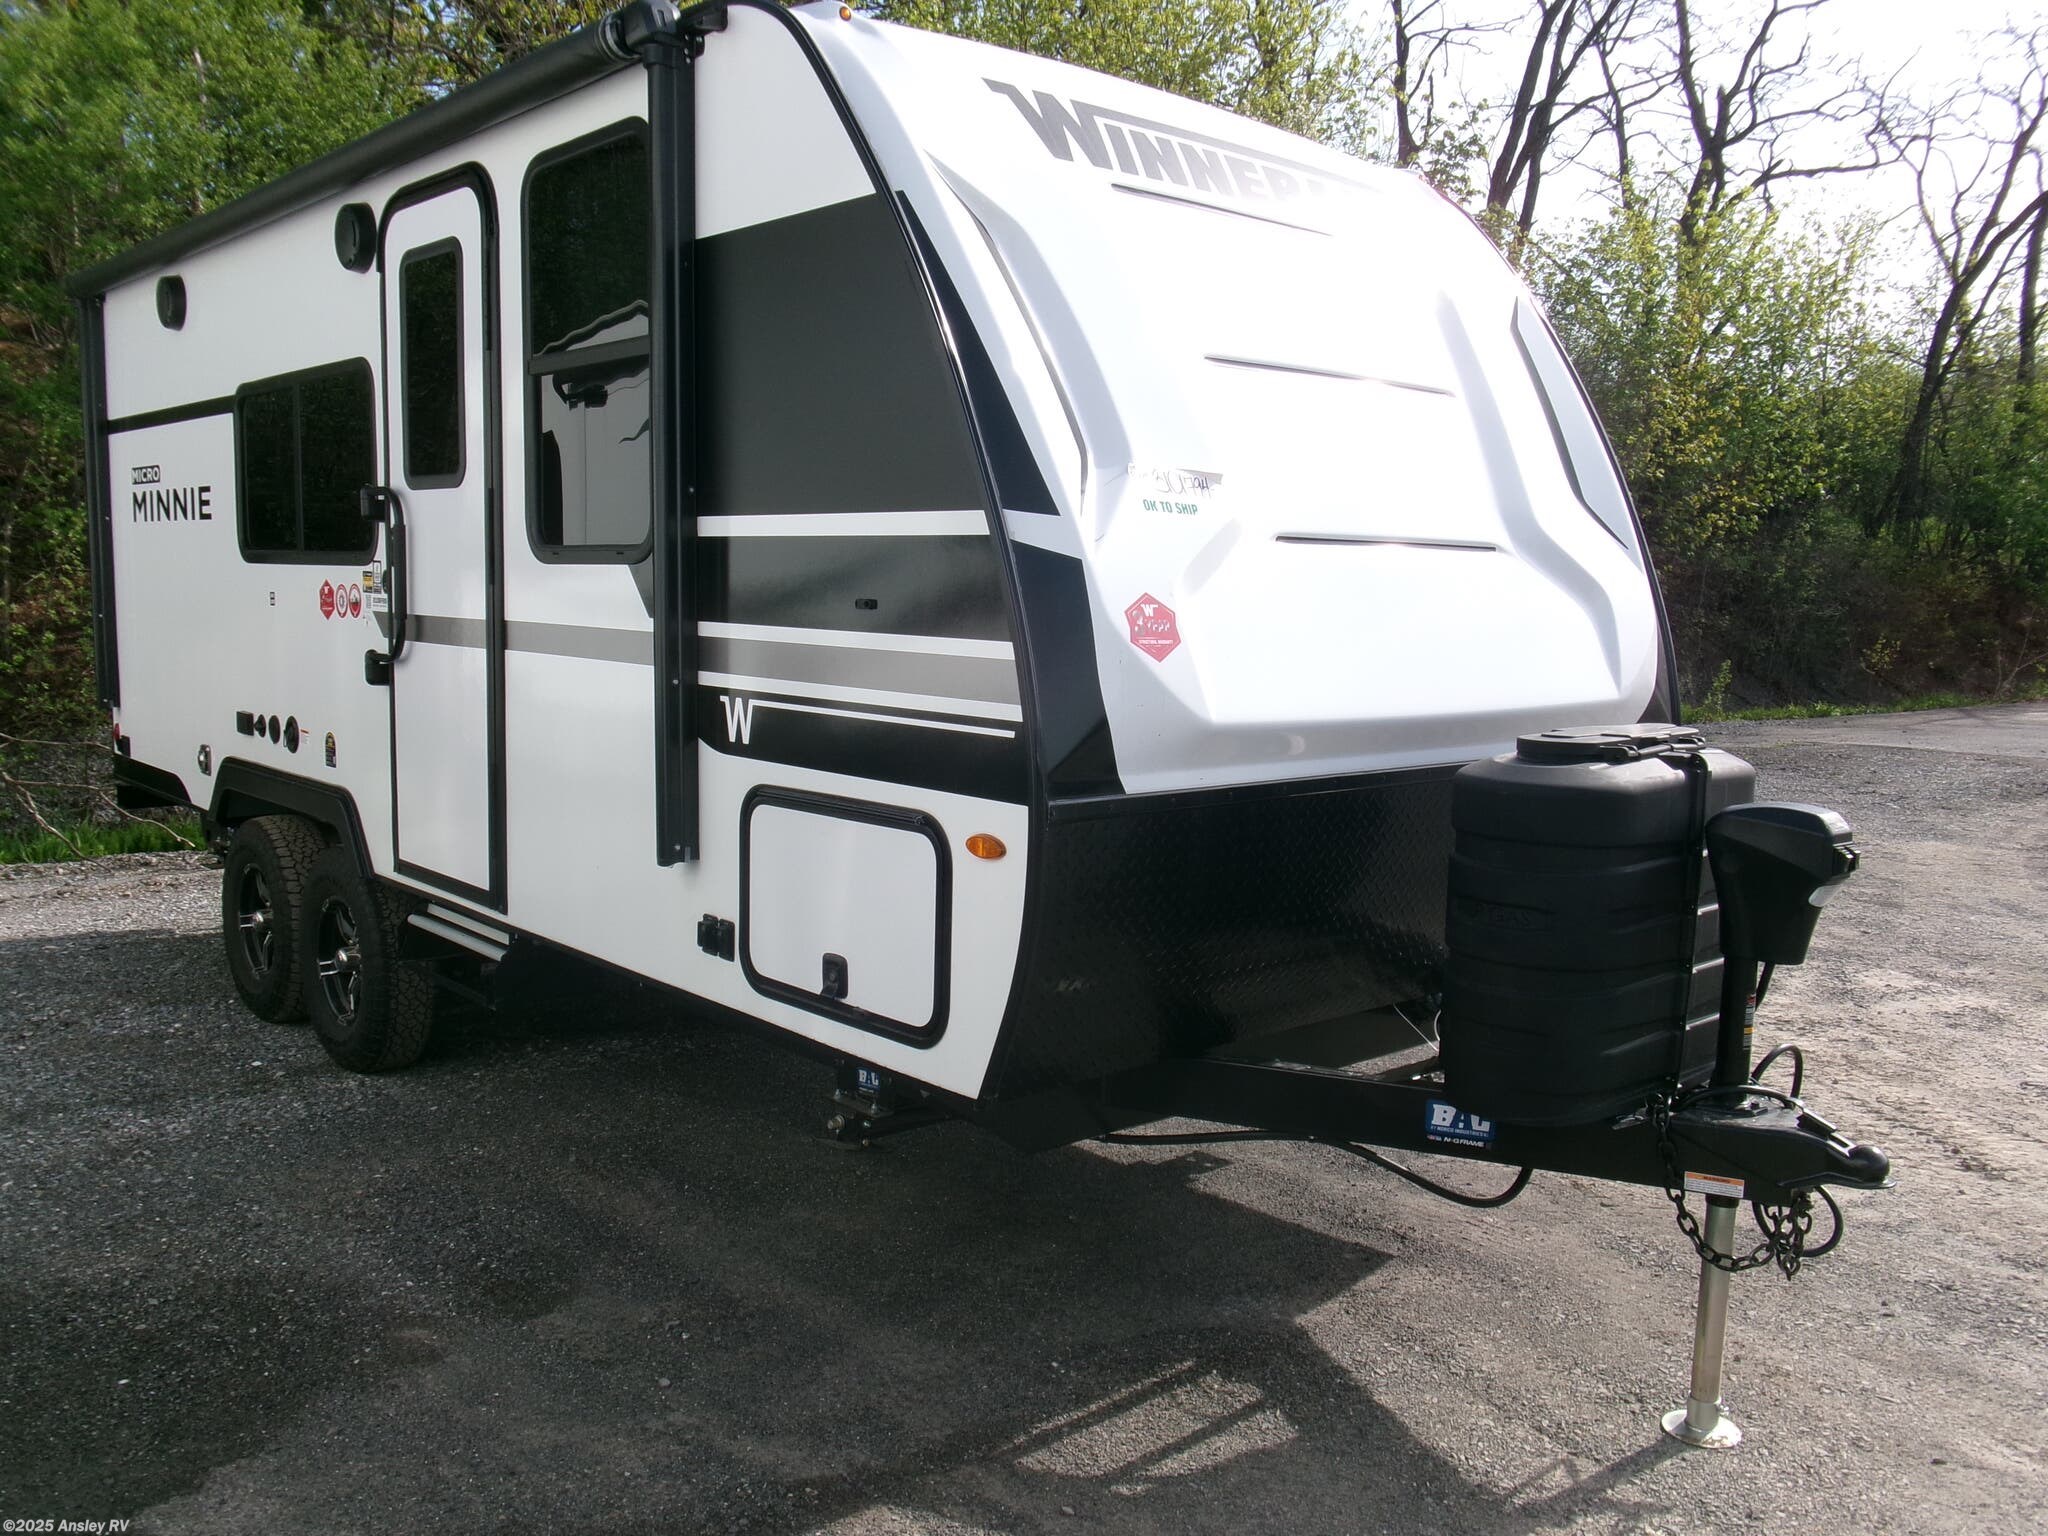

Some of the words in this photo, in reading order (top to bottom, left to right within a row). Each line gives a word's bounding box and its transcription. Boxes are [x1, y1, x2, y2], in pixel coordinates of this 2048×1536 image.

[131, 465, 161, 484] MICRO
[132, 486, 212, 523] MINNIE
[1143, 499, 1158, 512] OK
[1159, 501, 1173, 513] TO
[1175, 502, 1198, 516] SHIP
[720, 695, 754, 745] W
